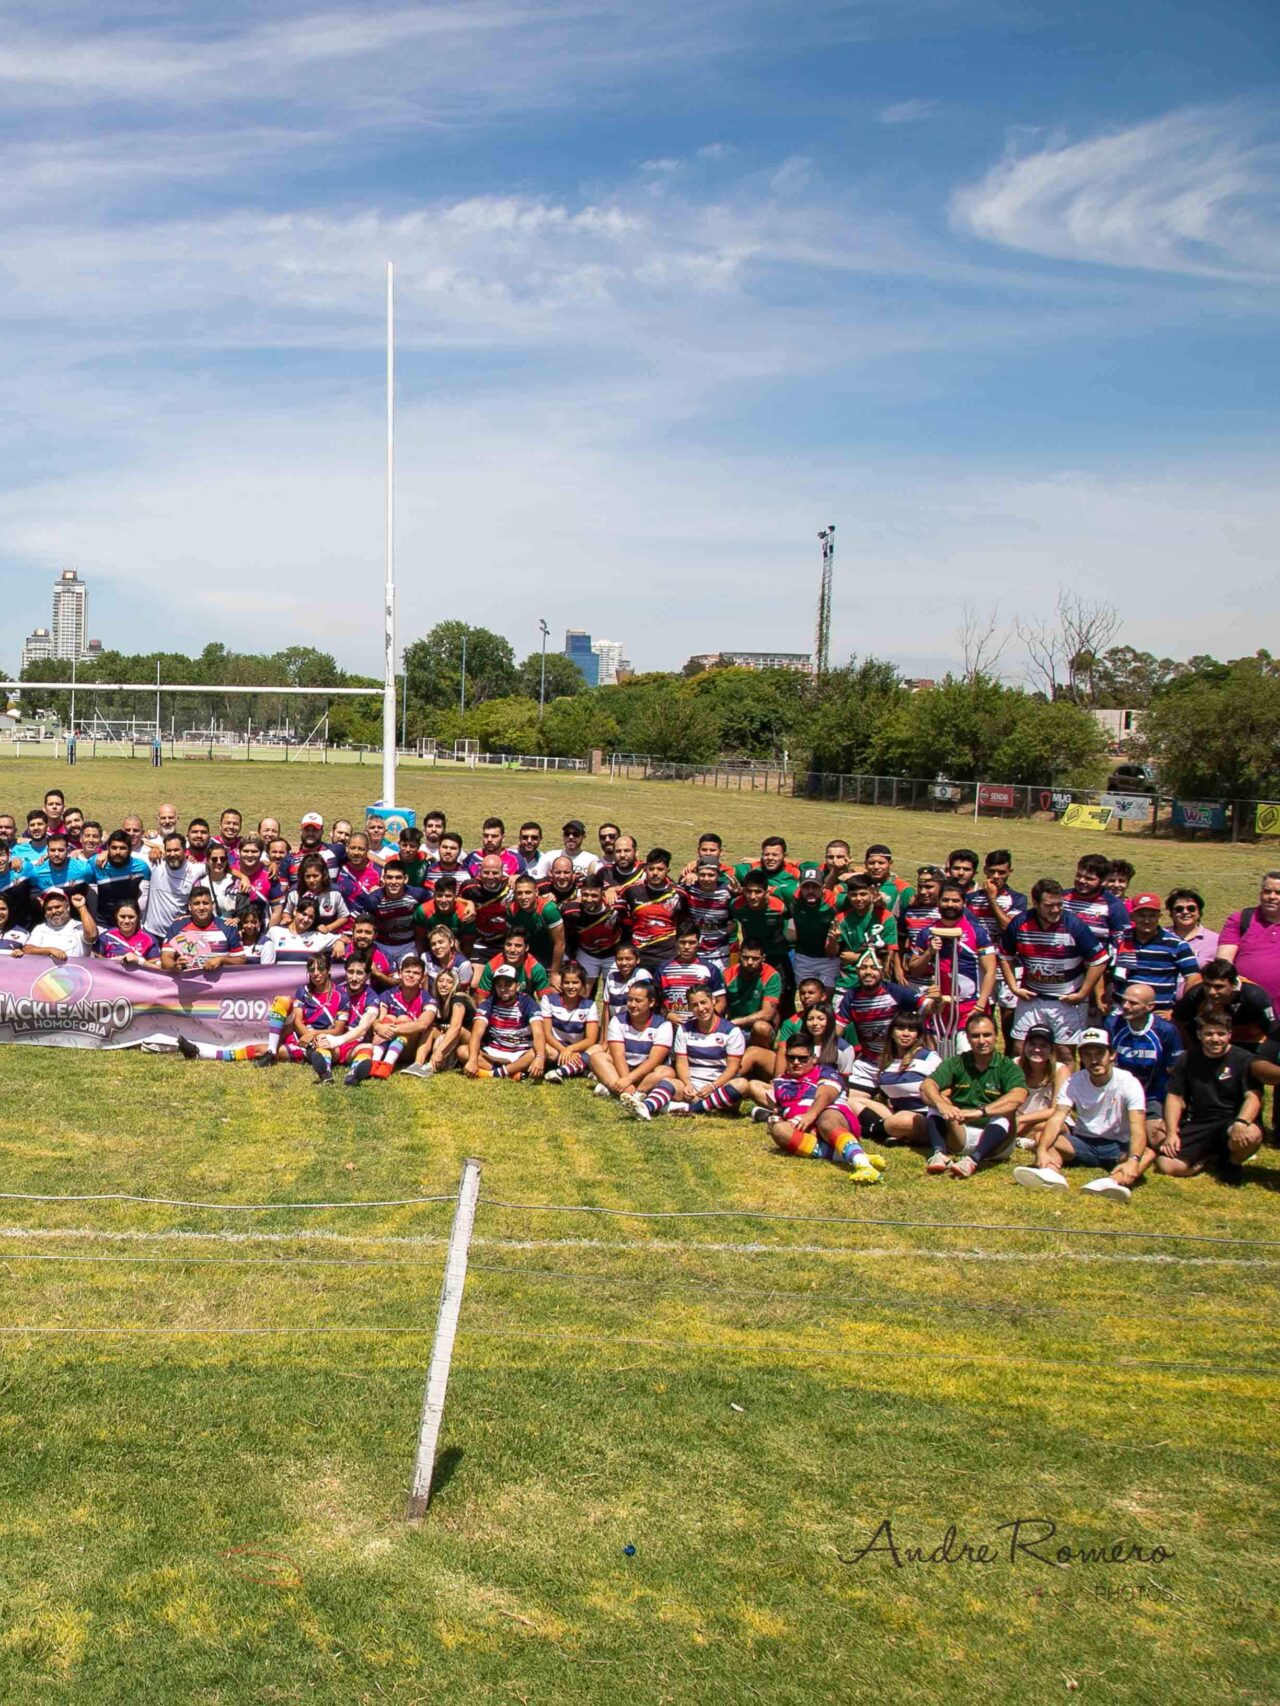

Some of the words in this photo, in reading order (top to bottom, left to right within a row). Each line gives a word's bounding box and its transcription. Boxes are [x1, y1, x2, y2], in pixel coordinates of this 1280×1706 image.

[1052, 793, 1072, 803] MUG
[221, 999, 268, 1020] 2019
[14, 1021, 31, 1031] LA
[34, 1019, 107, 1036] HOMOFOBIA
